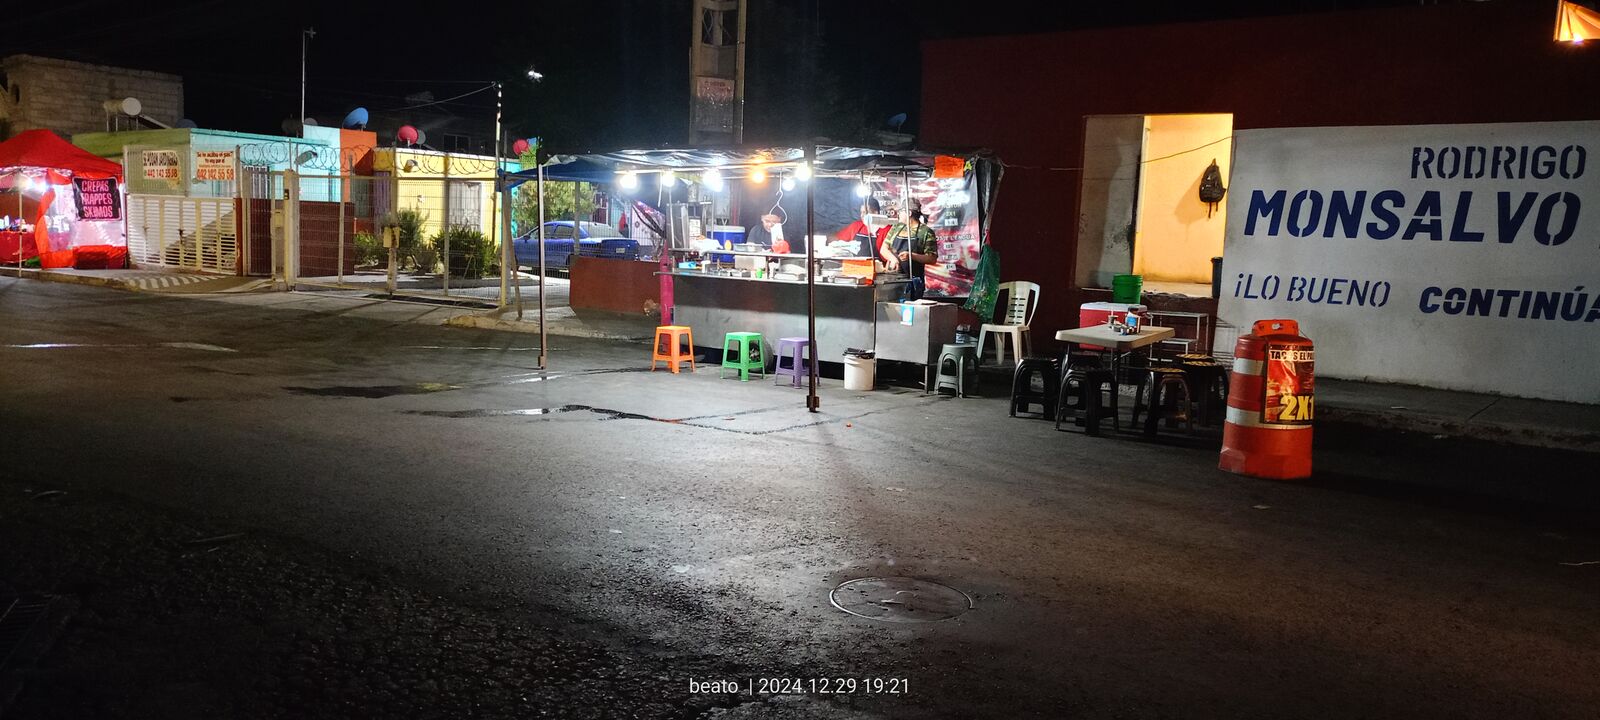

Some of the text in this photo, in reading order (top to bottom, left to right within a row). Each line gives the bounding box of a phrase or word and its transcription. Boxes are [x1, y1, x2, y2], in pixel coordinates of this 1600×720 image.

[1410, 144, 1587, 180] RODRIGO
[82, 180, 109, 192] CREPAS
[1244, 189, 1582, 246] MONSALVO
[1286, 276, 1391, 307] BUENO
[1270, 351, 1298, 360] TACS
[1300, 352, 1306, 360] EL
[1279, 395, 1314, 421] 2X1
